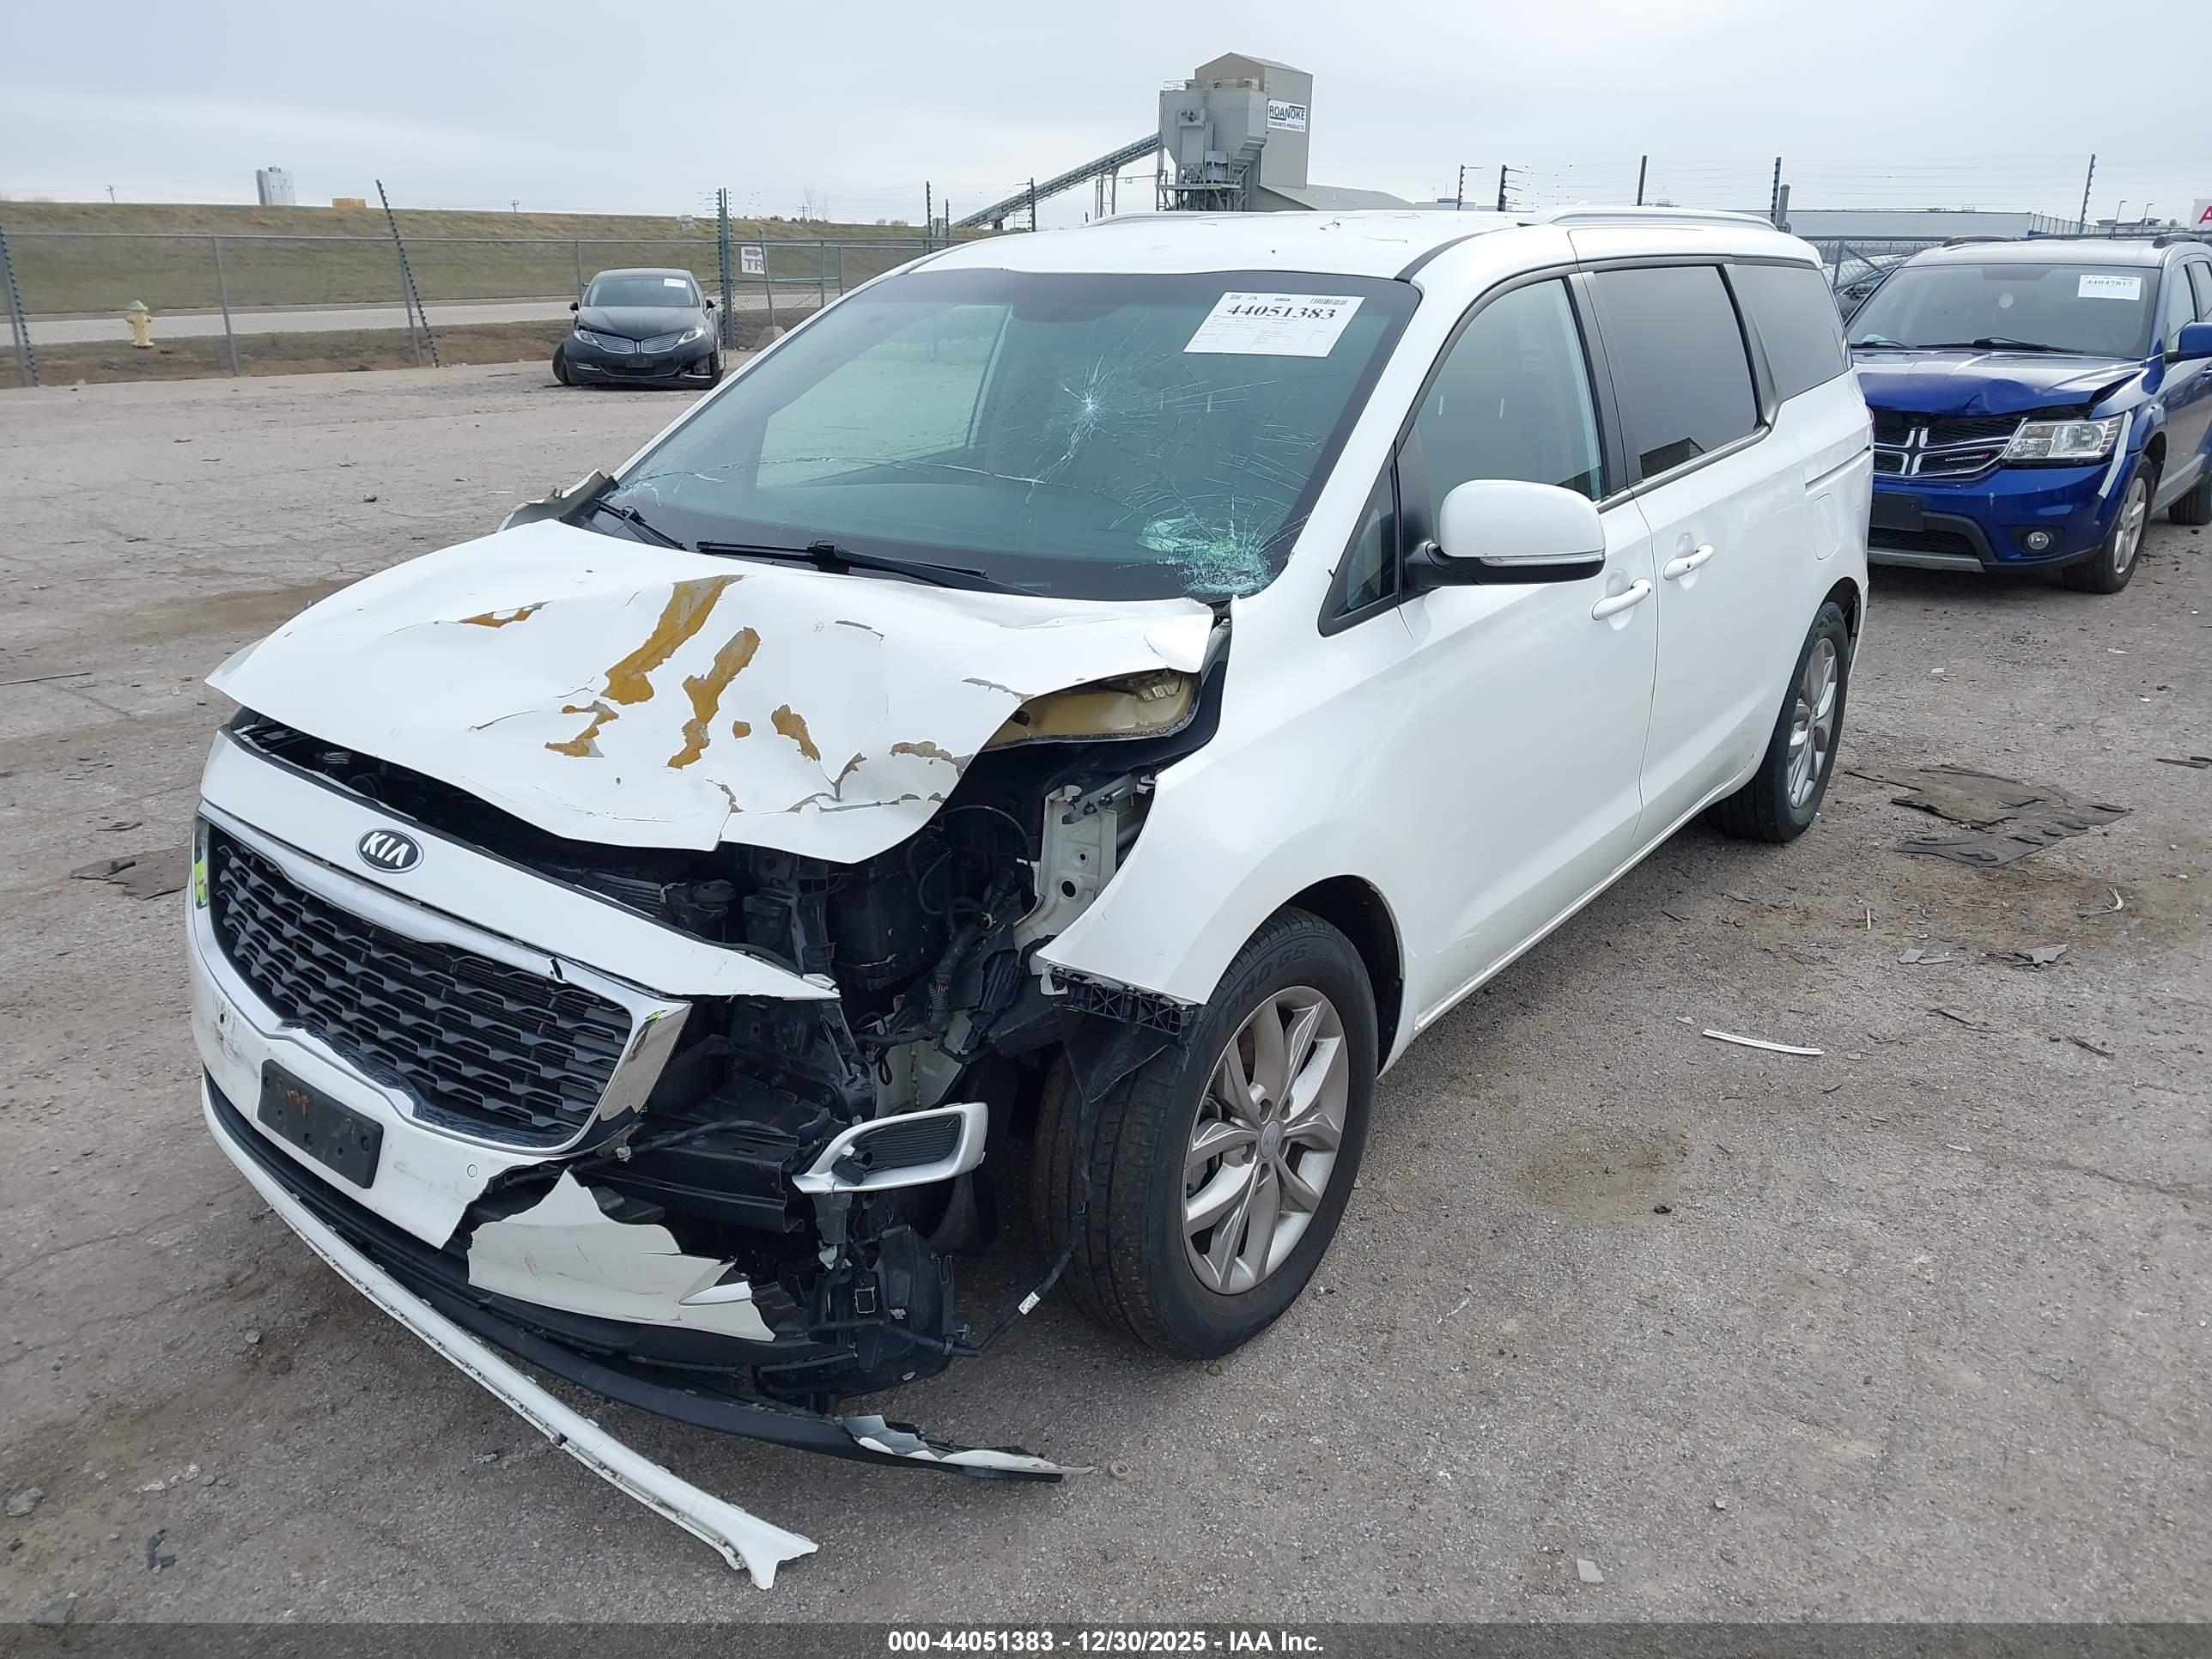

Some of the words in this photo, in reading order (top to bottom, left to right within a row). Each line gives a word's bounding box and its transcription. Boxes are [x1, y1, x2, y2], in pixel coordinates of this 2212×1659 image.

[1269, 105, 1305, 120] ROANOKE
[1227, 303, 1336, 320] 44051383
[1945, 453, 1984, 462] DODGE
[362, 831, 410, 868] KIA
